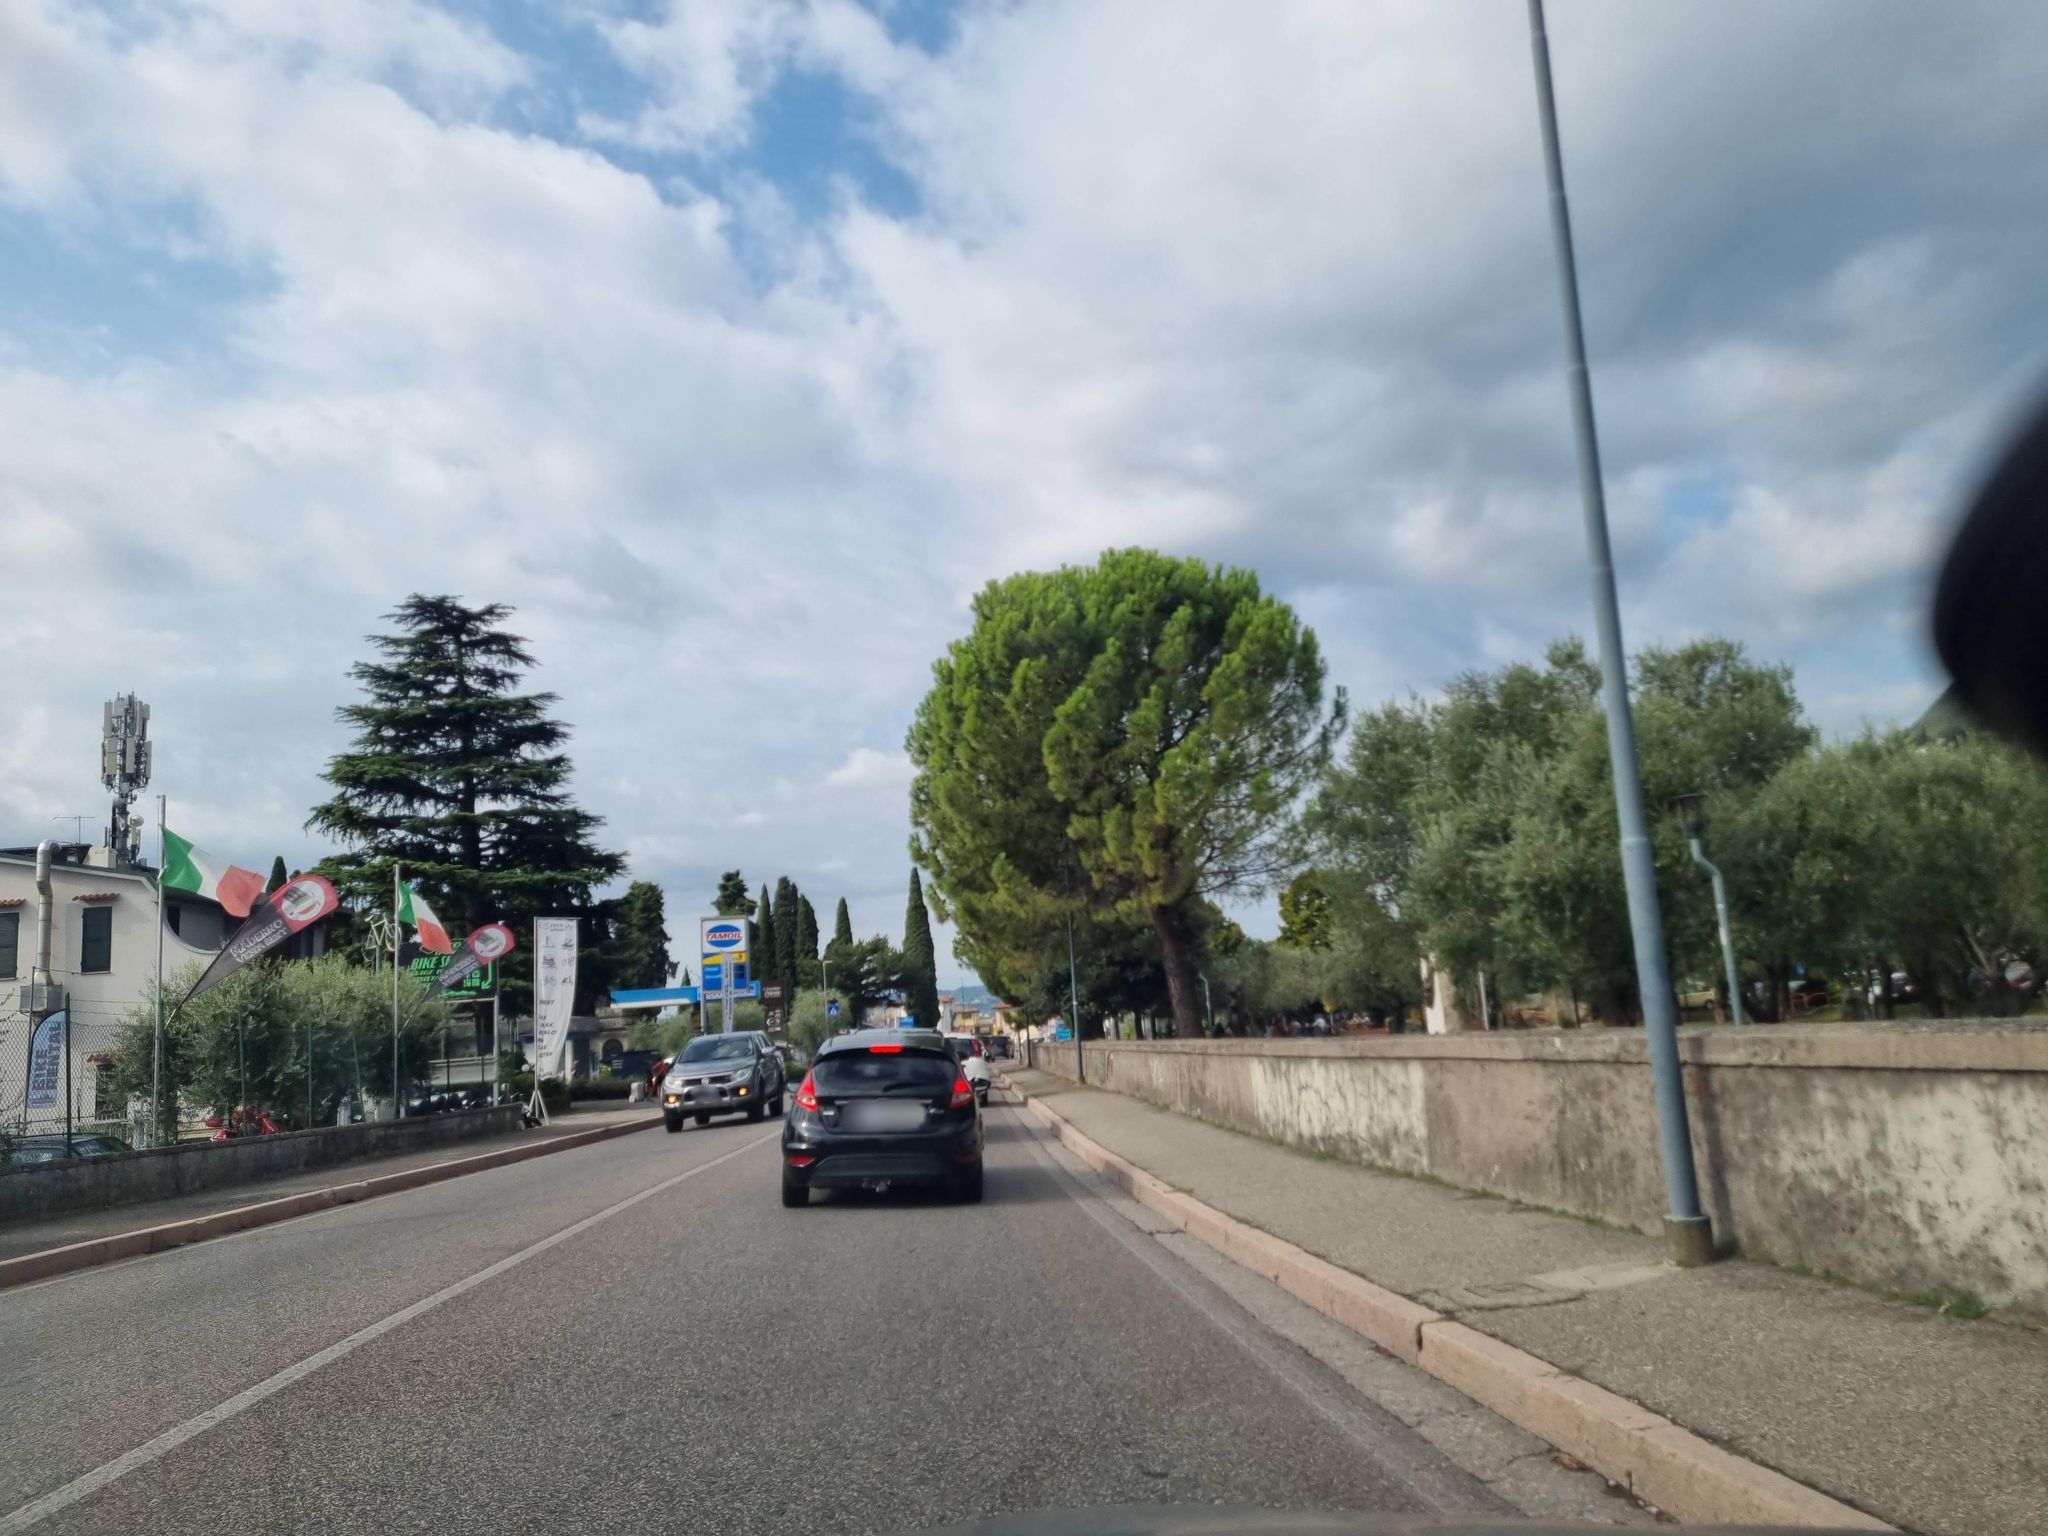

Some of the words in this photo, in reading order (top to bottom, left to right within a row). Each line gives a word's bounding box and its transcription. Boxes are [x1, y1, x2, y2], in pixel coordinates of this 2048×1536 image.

[229, 919, 283, 958] MADERNO
[704, 931, 743, 941] TAMOIL
[411, 956, 438, 970] BIKE
[32, 1048, 47, 1090] BIKE
[45, 1021, 61, 1090] RENTAL
